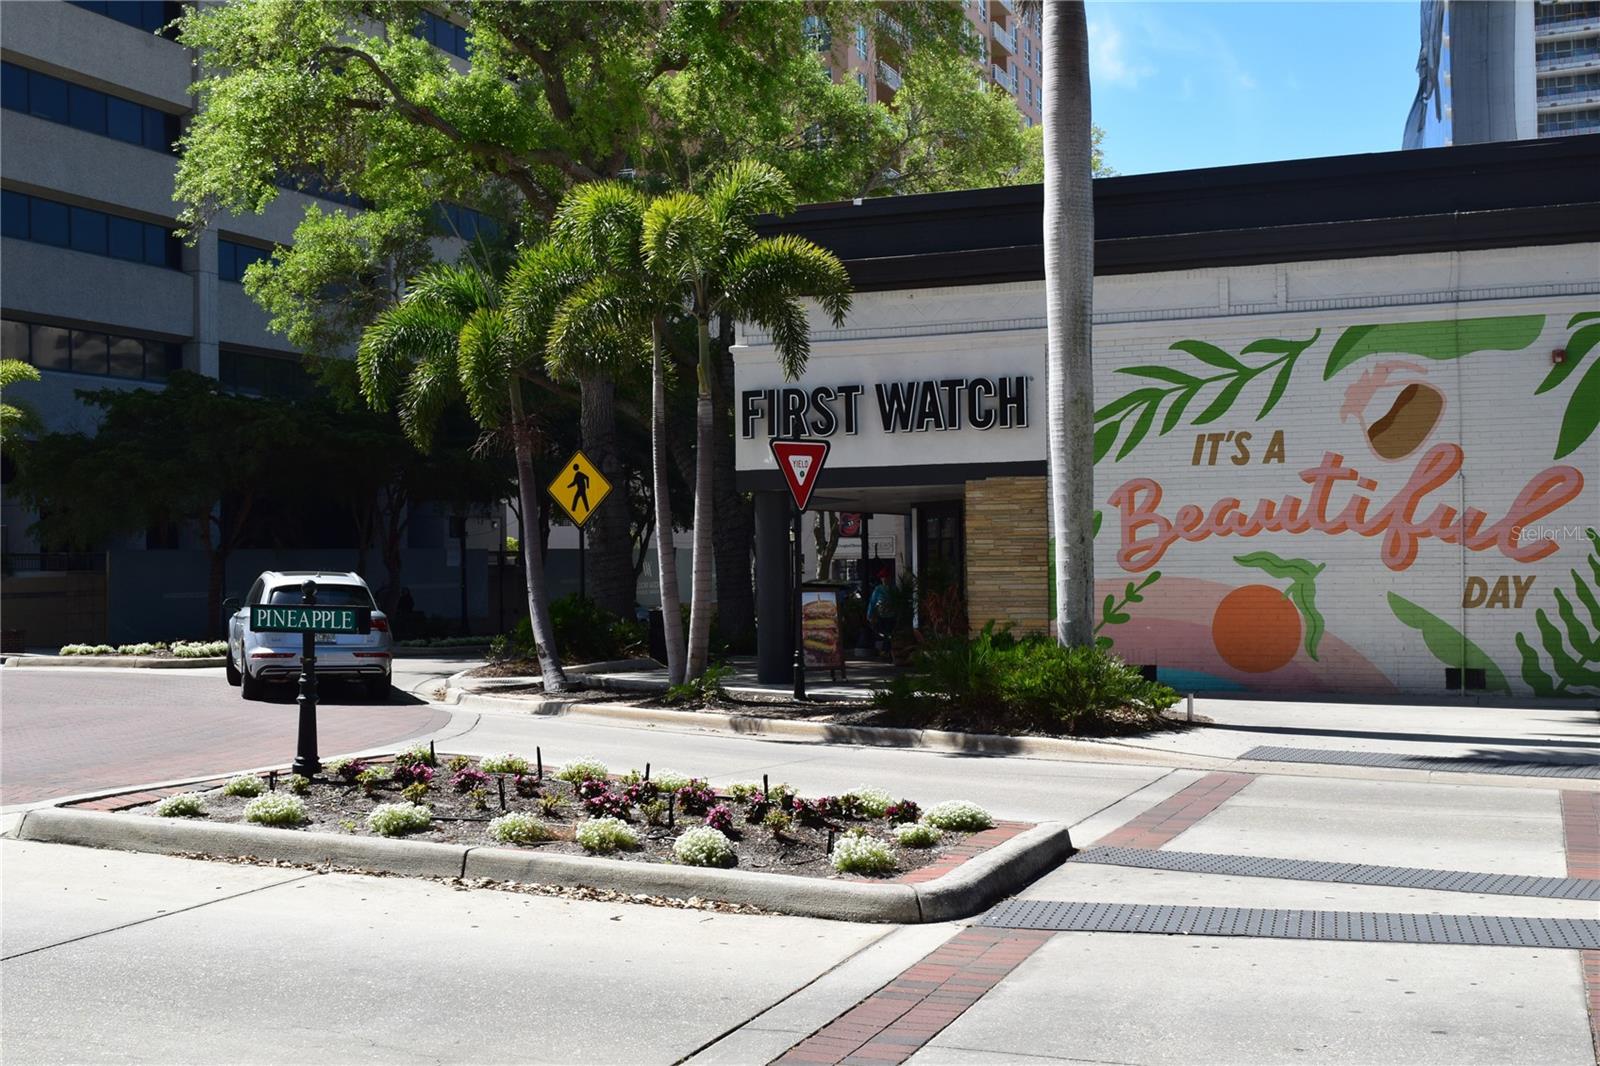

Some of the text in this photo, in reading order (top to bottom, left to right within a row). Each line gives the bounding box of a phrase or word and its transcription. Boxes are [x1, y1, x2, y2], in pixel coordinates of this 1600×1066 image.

[741, 376, 1030, 439] FIRST WATCH
[792, 459, 808, 468] YIELD
[1191, 429, 1285, 466] IT'S A
[1107, 442, 1584, 573] Beautiful
[1461, 575, 1536, 609] DAY
[256, 608, 353, 630] PINEAPPLE
